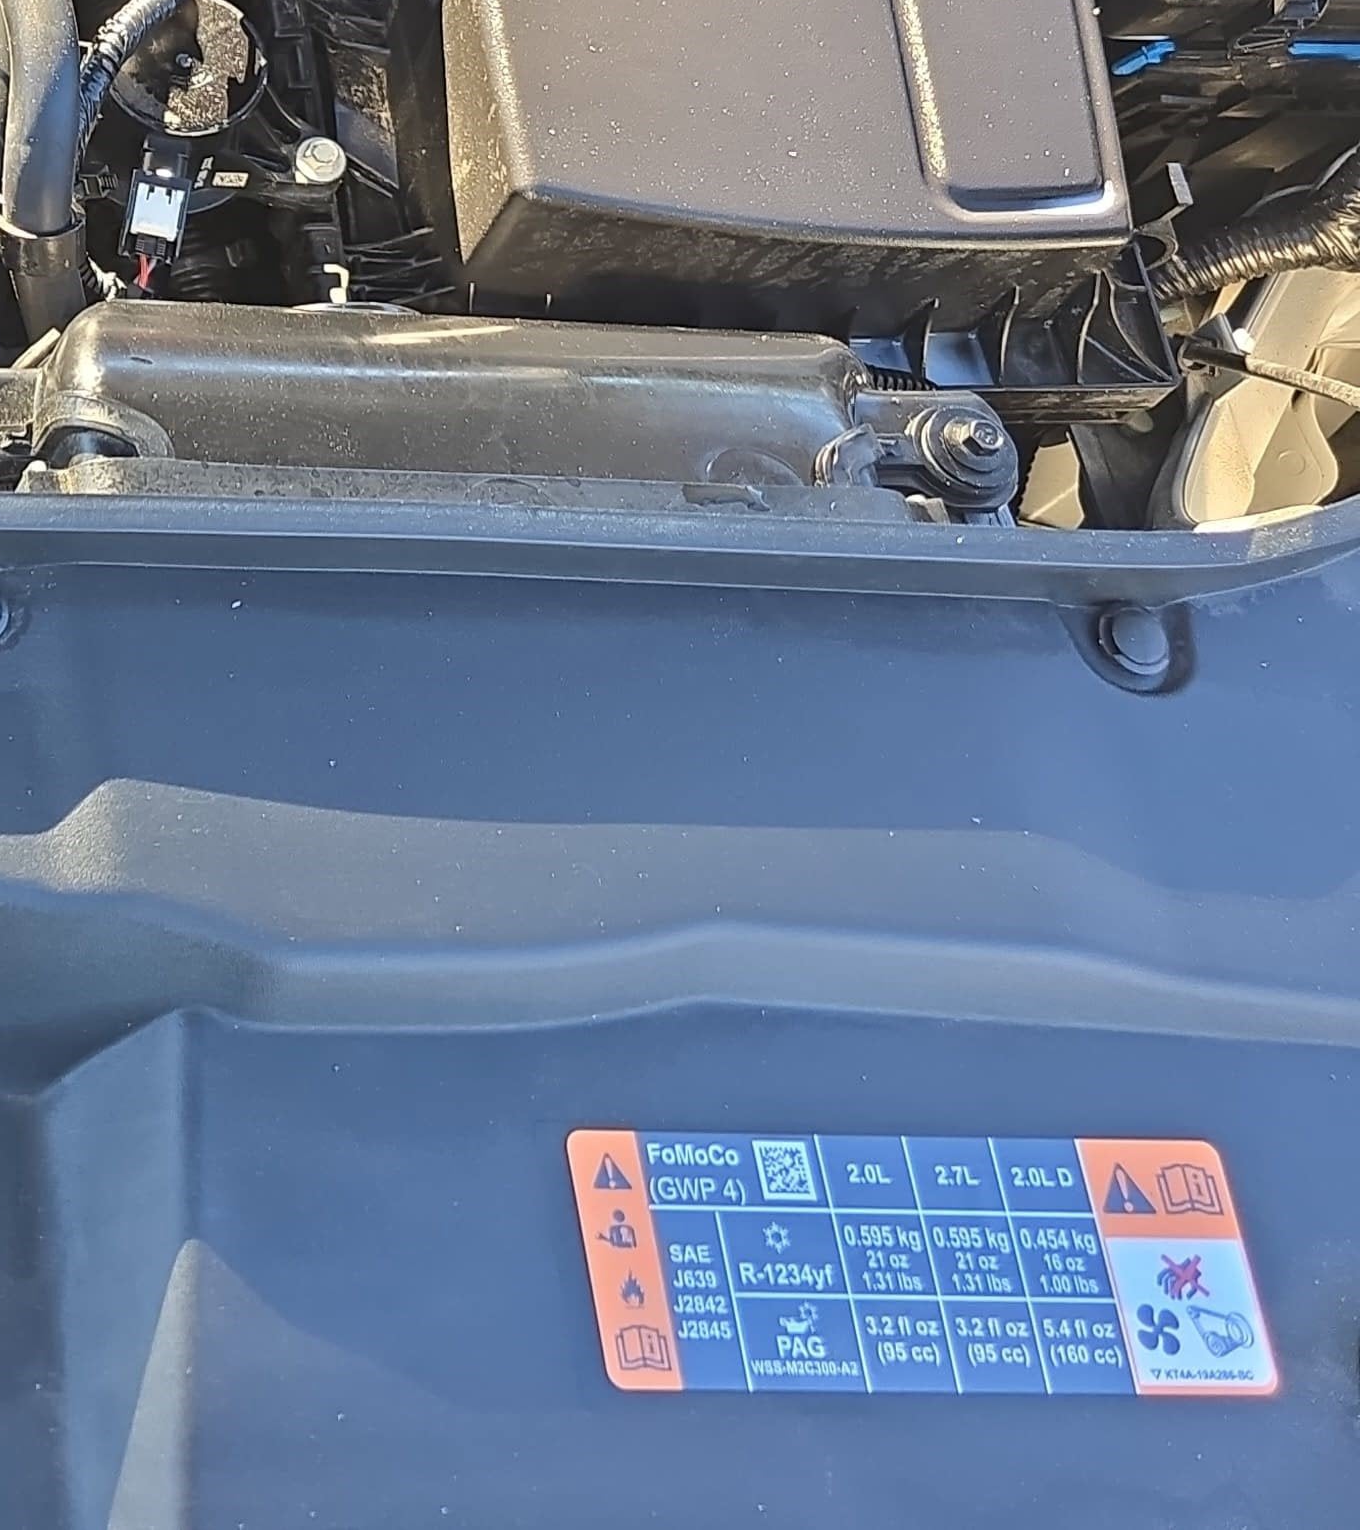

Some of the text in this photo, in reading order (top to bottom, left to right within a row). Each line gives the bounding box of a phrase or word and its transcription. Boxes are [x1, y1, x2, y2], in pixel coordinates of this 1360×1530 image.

[646, 1142, 739, 1166] FoMoCo
[846, 1163, 893, 1185] 2.0L
[934, 1165, 981, 1186] 2.7L
[1010, 1167, 1073, 1187] 2.0L D
[649, 1176, 747, 1205] (GWP 4)
[843, 1225, 922, 1252] 0.595 kg
[932, 1226, 1011, 1254] 0.595 kg
[1020, 1228, 1098, 1255] 0.454 kg
[669, 1244, 712, 1264] SAE
[866, 1250, 911, 1269] 21 oz
[955, 1251, 999, 1270] 21 oz
[1043, 1253, 1086, 1272] 16 oz
[673, 1270, 717, 1288] J639
[739, 1262, 834, 1290] R-1234yf
[862, 1271, 923, 1292] 1.31 lbs
[952, 1272, 1013, 1294] 1.31 lbs
[1040, 1275, 1099, 1295] 1.00 lbs
[674, 1295, 728, 1314] J2842
[678, 1320, 732, 1340] J2845
[864, 1316, 941, 1337] 3.2 fl oz
[956, 1317, 1030, 1338] 3.2 fl oz
[1043, 1318, 1116, 1339] 5.4 fl oz
[776, 1335, 827, 1359] PAG
[877, 1342, 941, 1366] (95 cc)
[968, 1343, 1031, 1367] (95 cc)
[1050, 1344, 1123, 1369] (160 cc)
